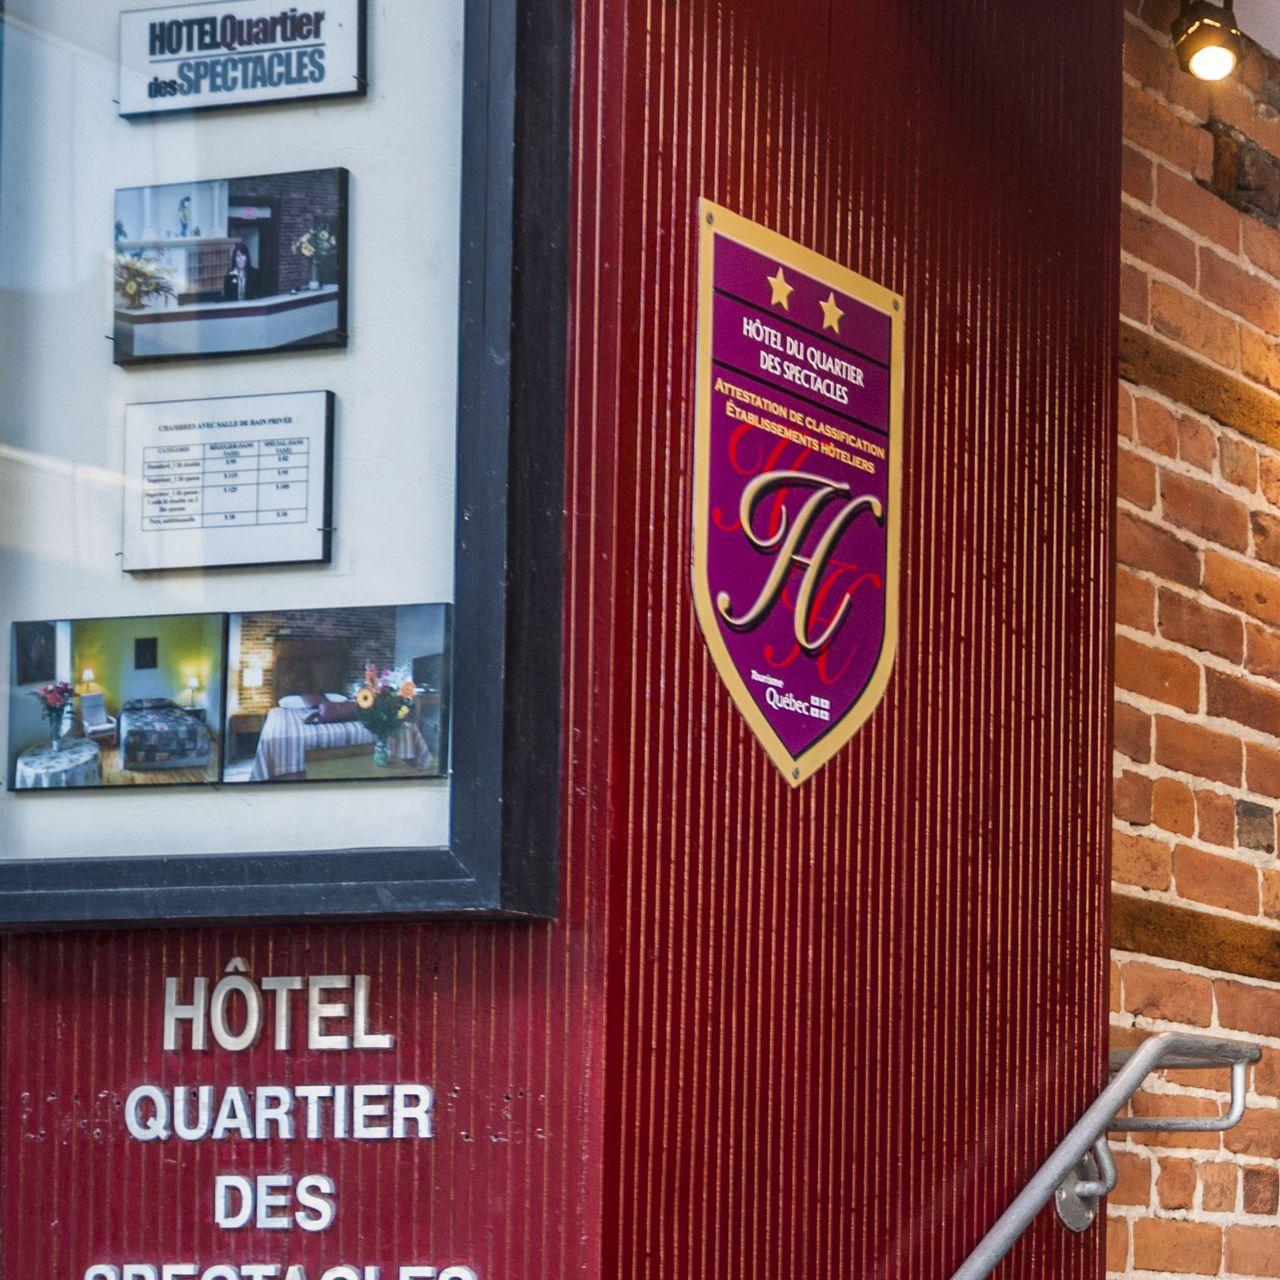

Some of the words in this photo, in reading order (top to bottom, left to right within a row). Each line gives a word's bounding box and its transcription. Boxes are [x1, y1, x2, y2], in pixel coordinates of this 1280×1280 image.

[742, 316, 783, 351] HÔTEL
[786, 335, 804, 357] DU
[807, 346, 864, 388] QUARTIER
[759, 350, 782, 376] DES
[783, 361, 849, 405] SPECTACLES
[714, 377, 788, 420] ATTESTATION
[789, 405, 804, 425] DE
[805, 415, 886, 460] CLASSIFICATION
[725, 399, 820, 451] ÉTABLISSEMENTS
[820, 435, 876, 475] HÔTELIERS
[765, 687, 810, 715] Québec
[163, 956, 395, 1052] HÔTEL
[124, 1083, 435, 1143] QUARTIER
[213, 1173, 337, 1232] DES
